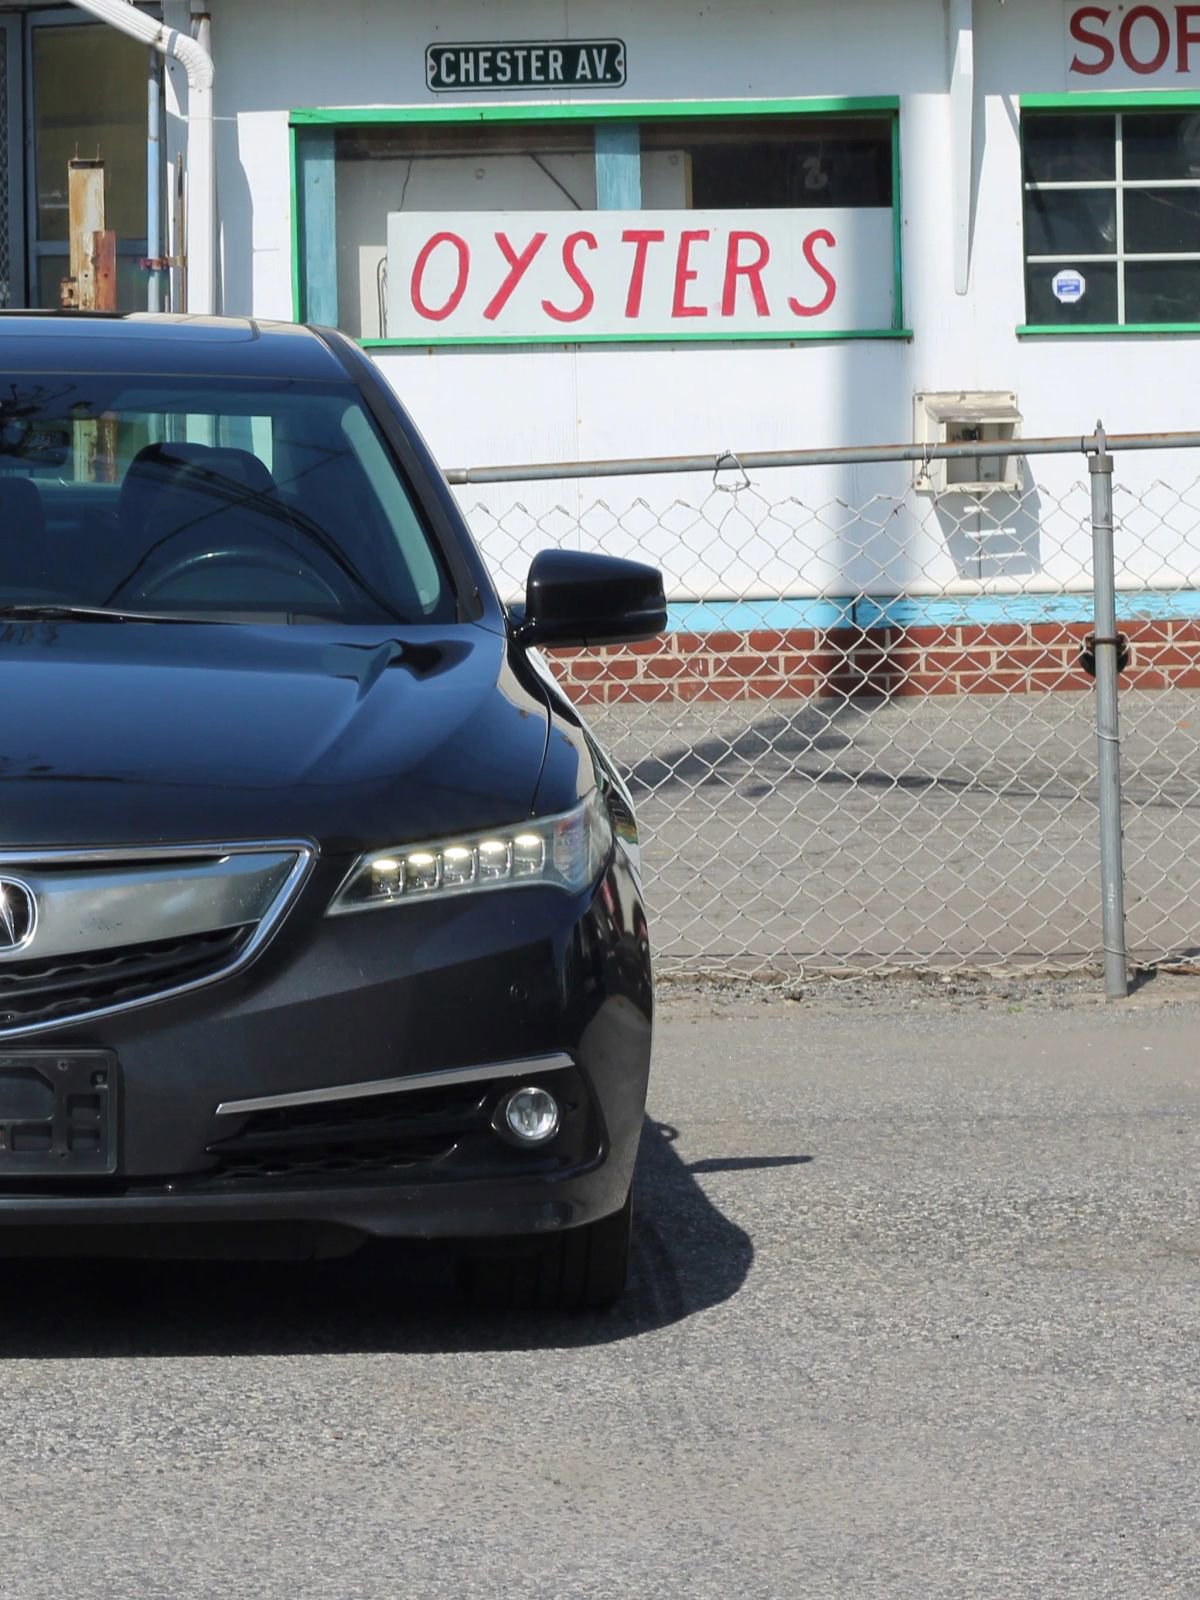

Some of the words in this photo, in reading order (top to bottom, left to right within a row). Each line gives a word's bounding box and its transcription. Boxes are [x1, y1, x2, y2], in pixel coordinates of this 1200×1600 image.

[440, 49, 564, 84] CHESTER
[576, 47, 612, 80] AV.
[410, 229, 837, 321] OYSTERS
